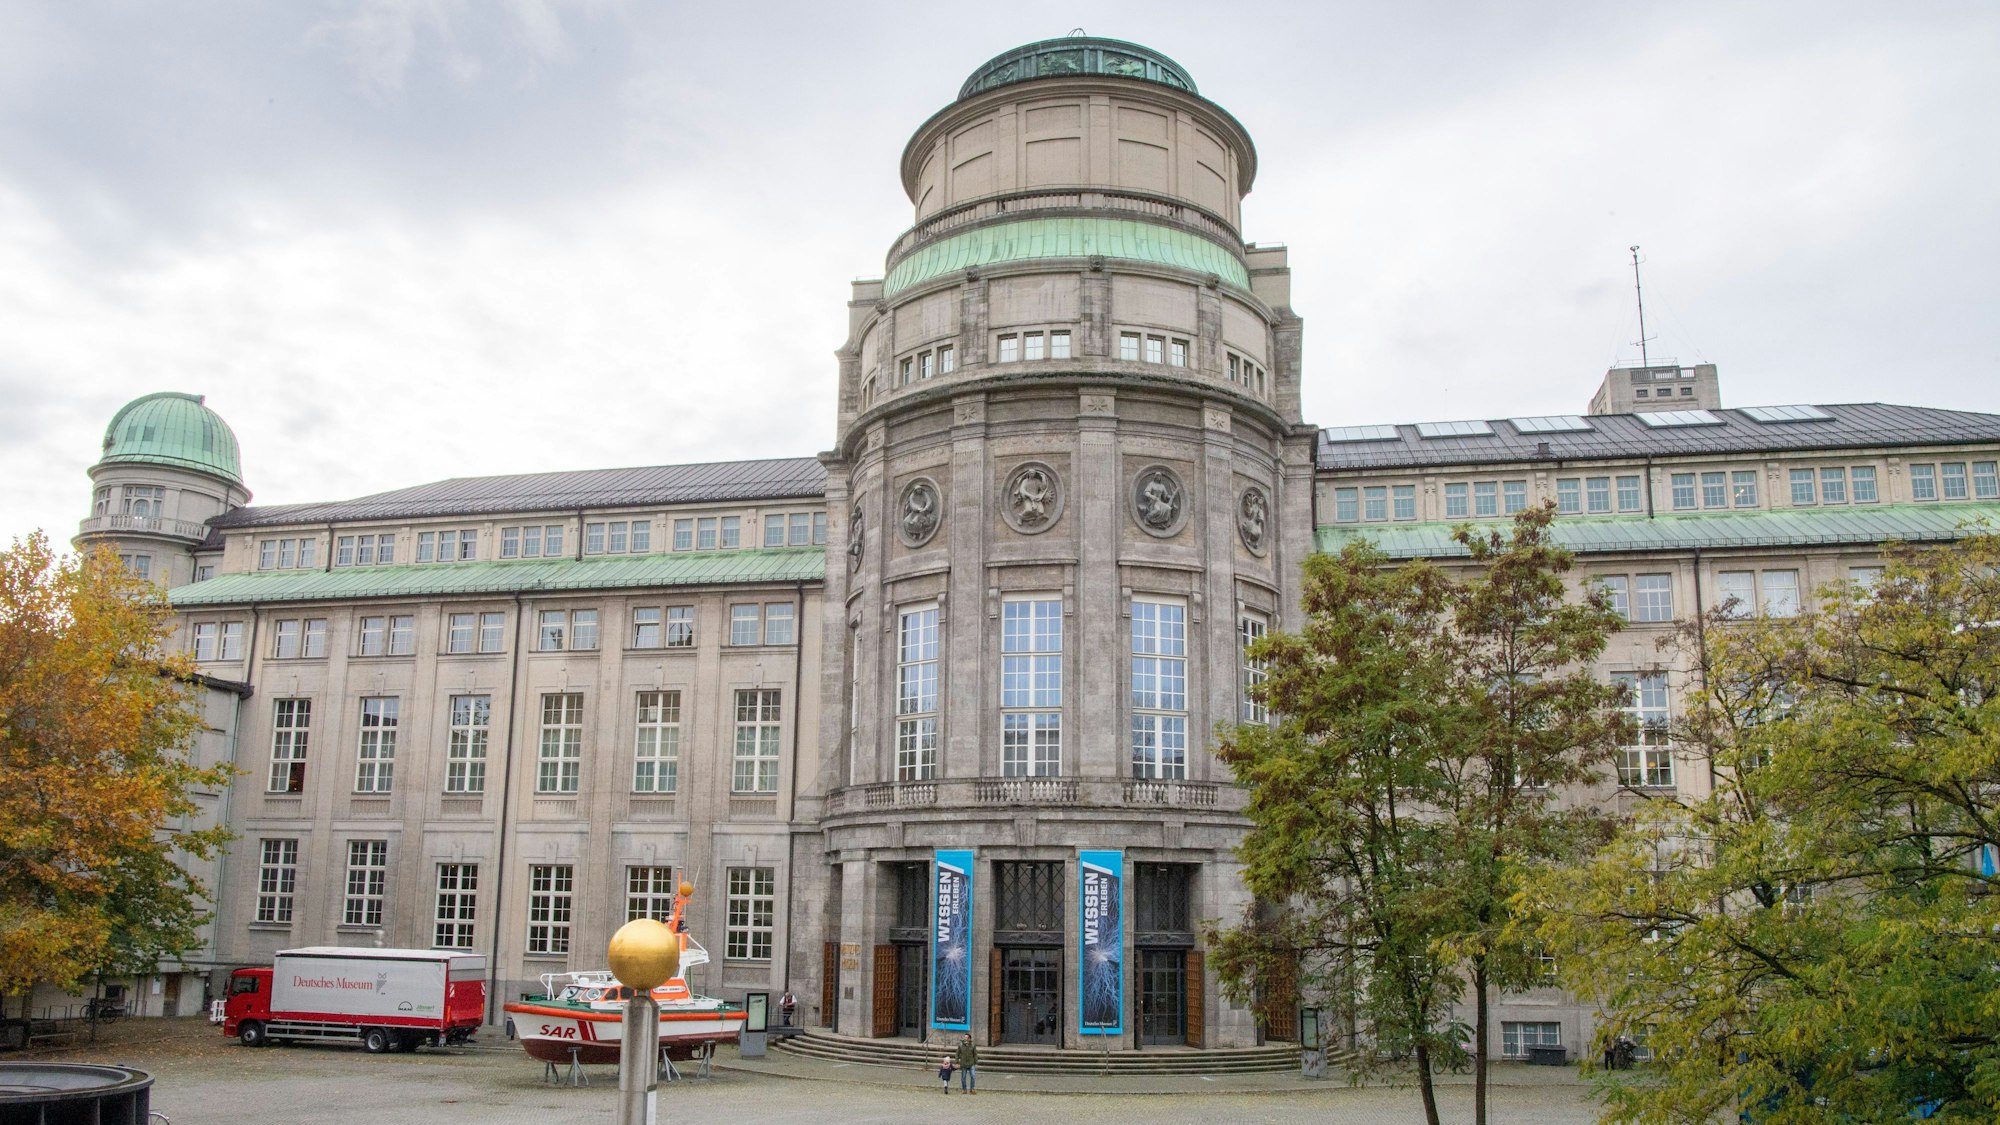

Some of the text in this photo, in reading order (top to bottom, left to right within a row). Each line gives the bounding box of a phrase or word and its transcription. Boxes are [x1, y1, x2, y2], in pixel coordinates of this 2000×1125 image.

[938, 871, 952, 943] WISSEN
[1084, 872, 1099, 945] WISSEN
[1100, 877, 1108, 917] ERLEBEN
[293, 975, 373, 990] Deutsches Museum
[539, 1024, 576, 1039] SAR
